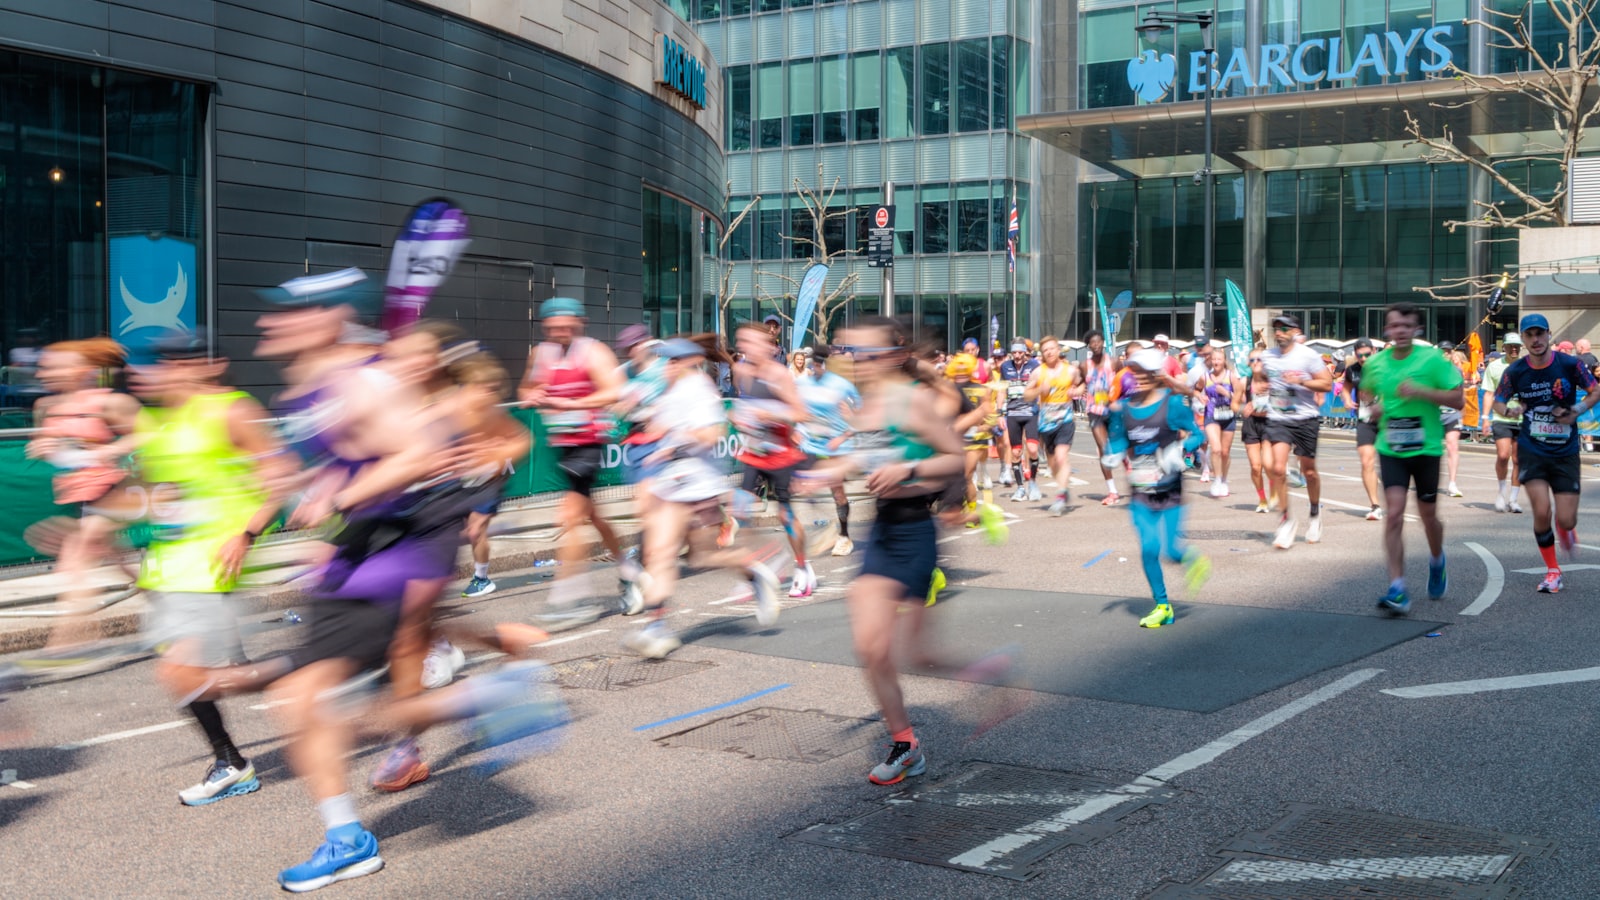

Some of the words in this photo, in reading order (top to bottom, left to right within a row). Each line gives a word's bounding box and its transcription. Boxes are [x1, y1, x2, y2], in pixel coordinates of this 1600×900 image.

[663, 34, 707, 110] BREWDOG
[1188, 25, 1454, 94] BARCLAYS
[1520, 388, 1551, 397] Research
[1531, 381, 1551, 390] Brain
